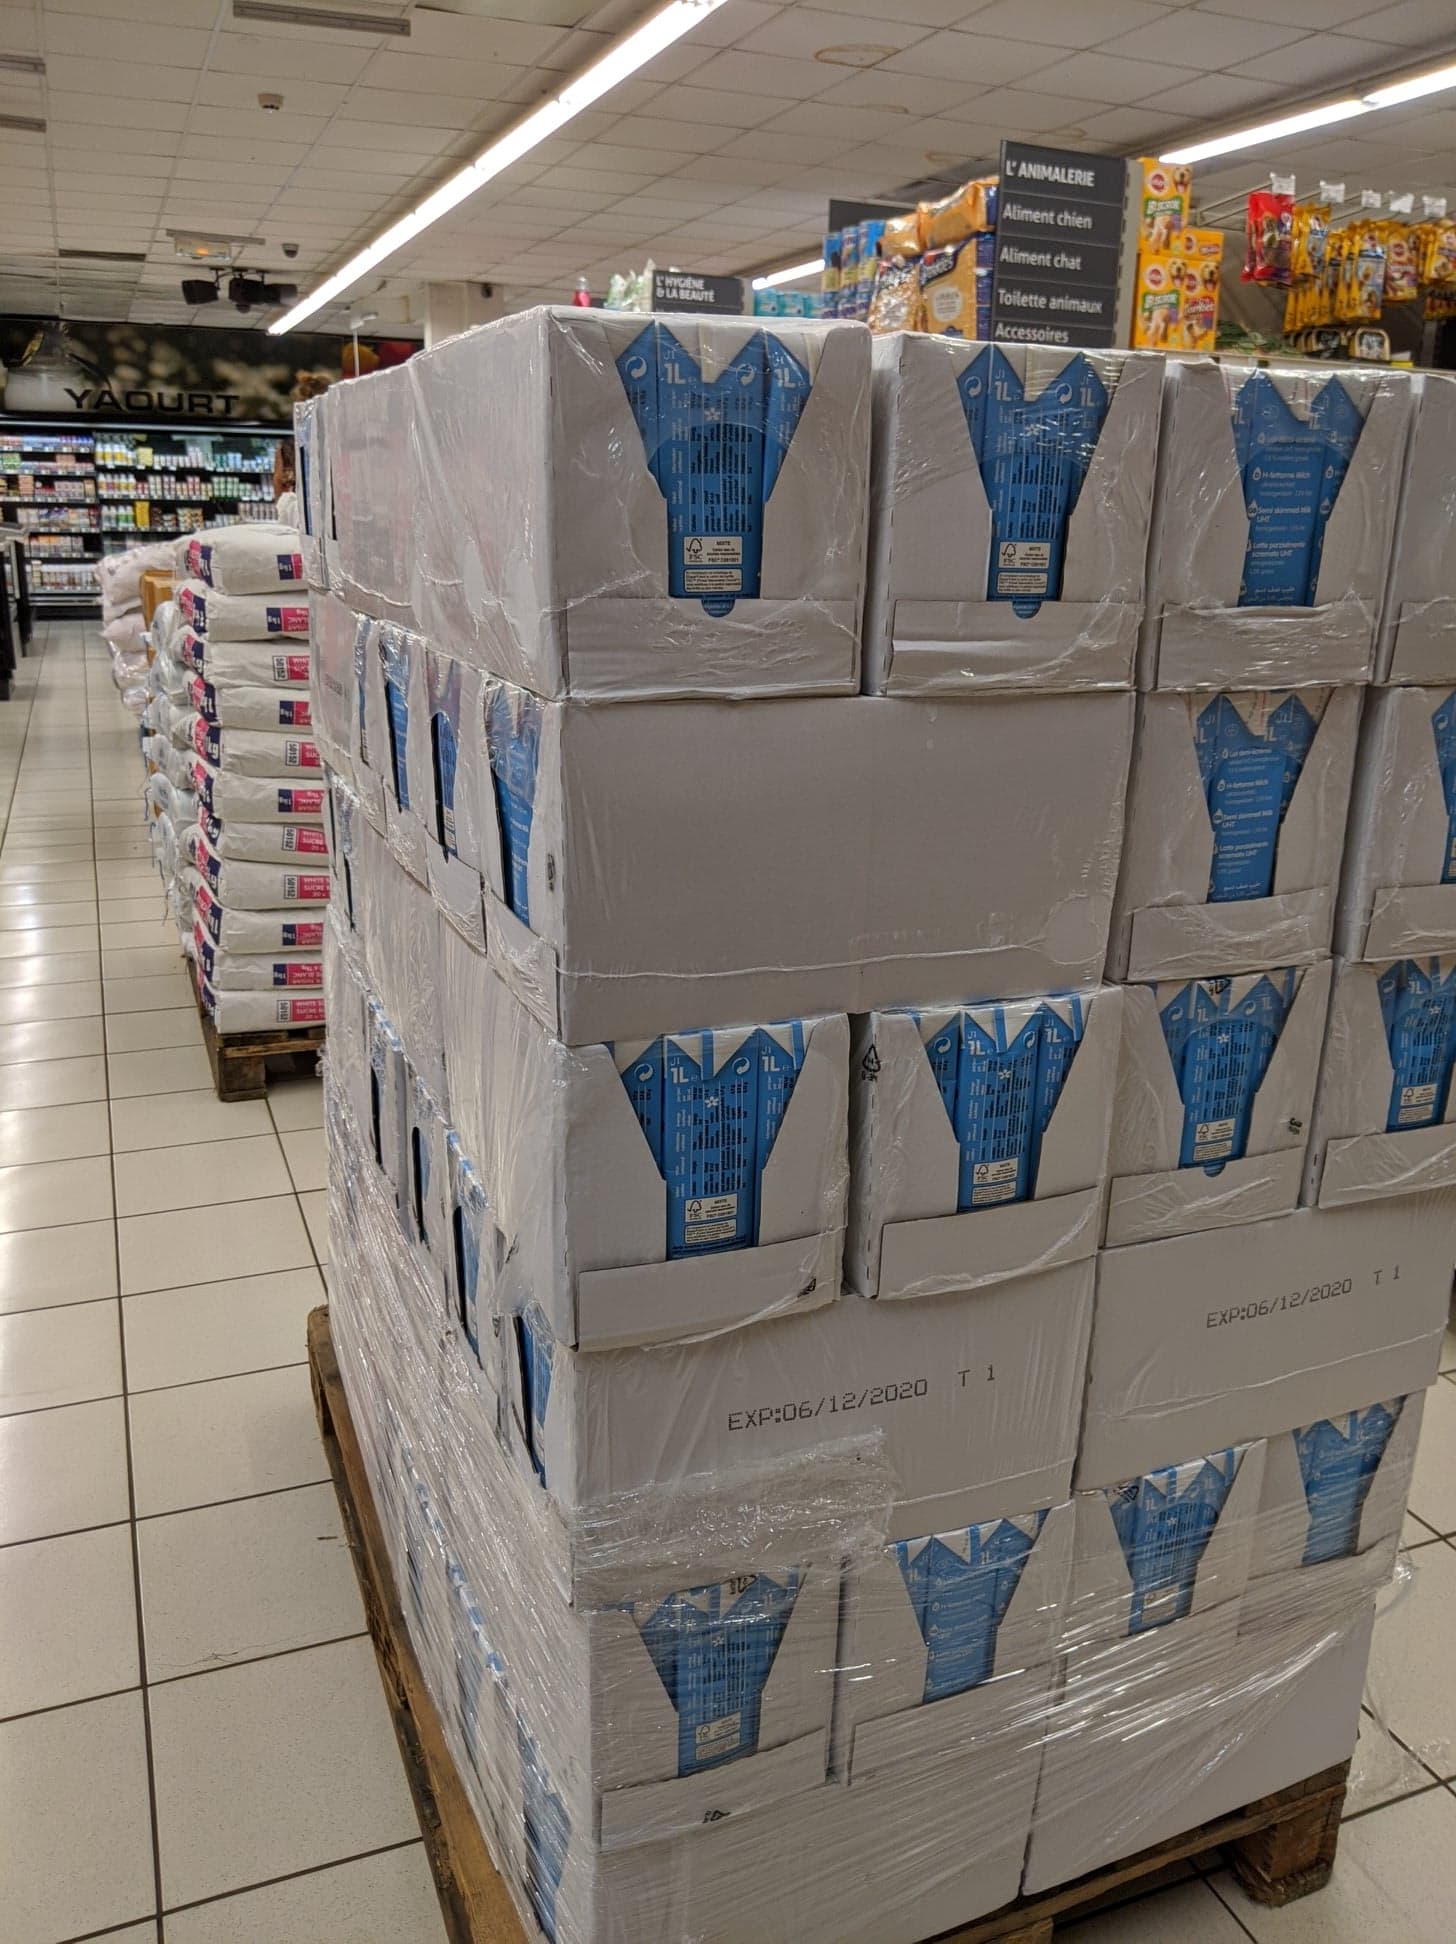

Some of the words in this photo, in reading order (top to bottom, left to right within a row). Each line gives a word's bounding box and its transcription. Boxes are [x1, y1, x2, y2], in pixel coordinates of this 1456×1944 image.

[1018, 162, 1095, 187] ANIMALERIE
[1003, 203, 1054, 226] Aliment
[1057, 211, 1092, 229] chien
[1000, 248, 1051, 268] Aliment
[1054, 251, 1081, 271] chat
[679, 289, 715, 302] BEAUTÉ
[998, 289, 1047, 309] Toilette
[1050, 296, 1102, 314] animaux
[995, 322, 1069, 344] Accessoires
[664, 364, 686, 385] 1L
[64, 388, 240, 415] YAOURT
[671, 1067, 689, 1084] 1L
[761, 1055, 780, 1073] 1L
[1206, 1278, 1352, 1328] EXP:06/12/2020
[1373, 1270, 1383, 1285] T
[1393, 1265, 1400, 1280] 1
[727, 1378, 929, 1431] EXP:06/12/2020
[957, 1369, 971, 1388] T
[986, 1364, 996, 1382] 1
